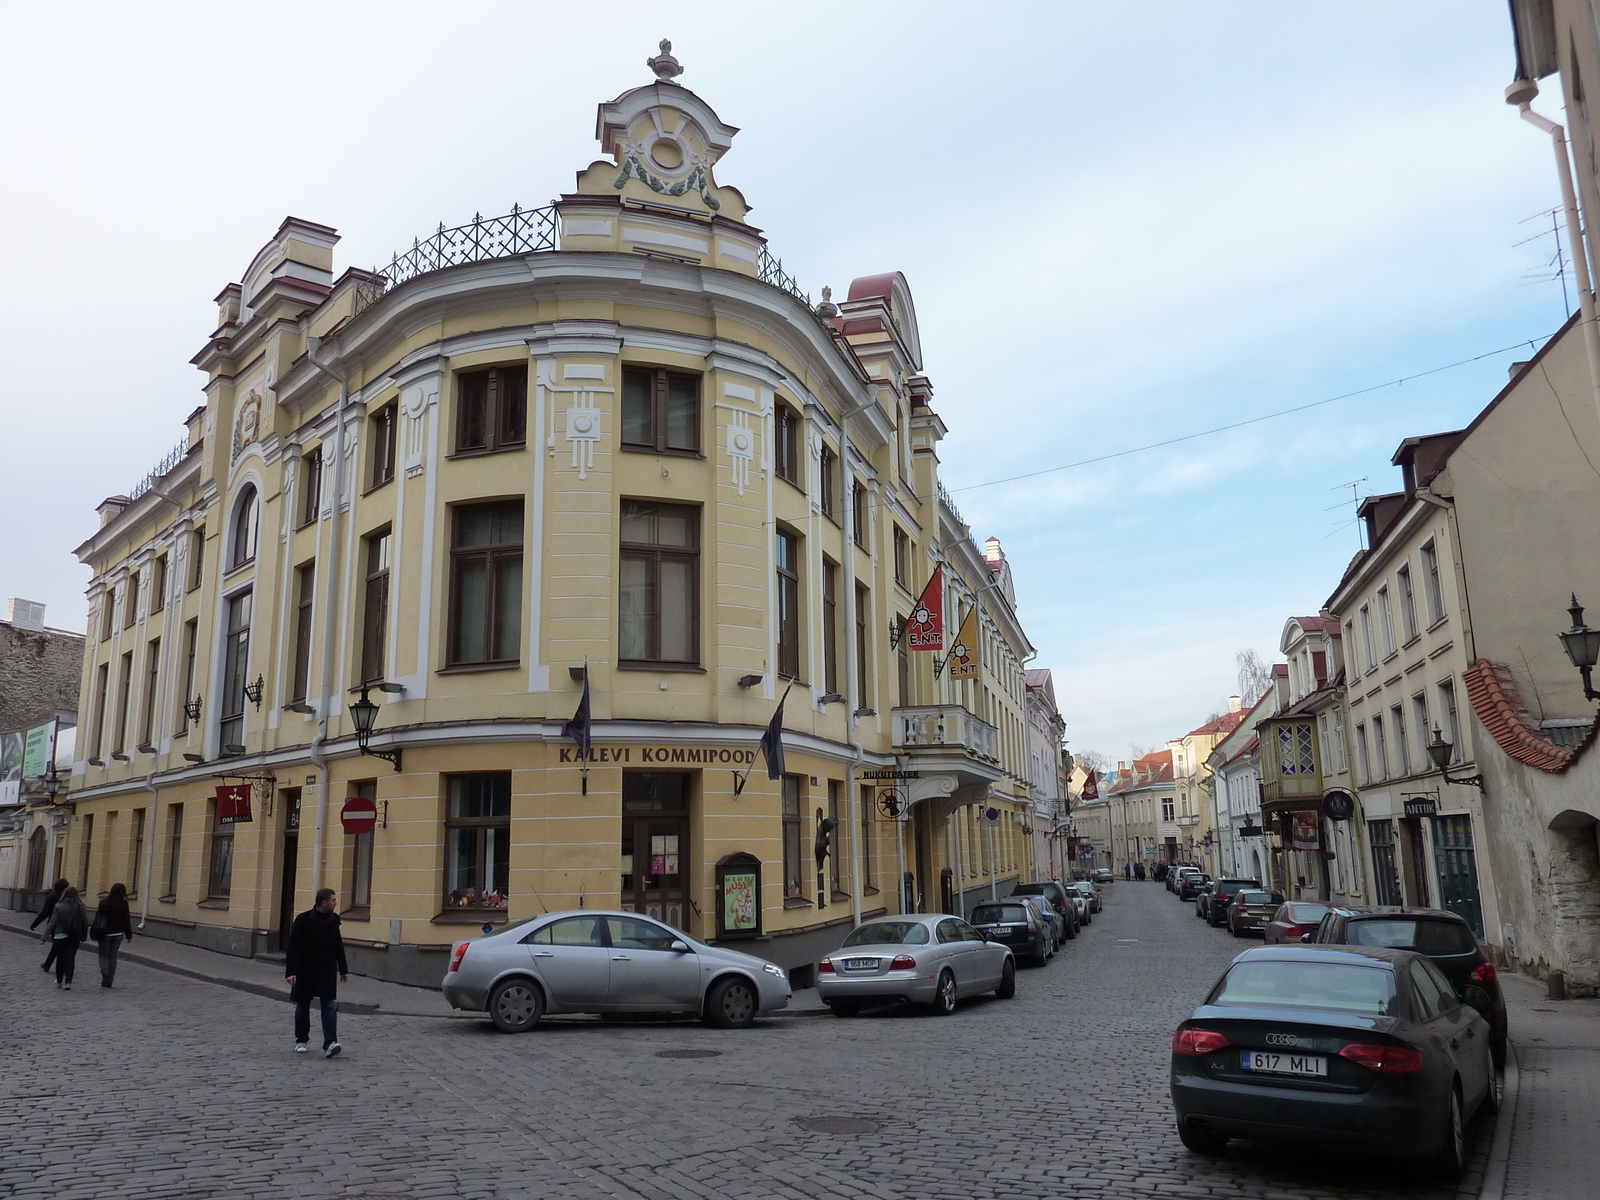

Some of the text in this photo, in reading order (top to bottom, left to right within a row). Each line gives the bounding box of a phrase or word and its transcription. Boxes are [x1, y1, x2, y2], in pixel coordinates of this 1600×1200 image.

[909, 633, 942, 645] E.N.T.
[950, 664, 978, 675] E.N.T.
[559, 748, 756, 764] KALEVI KOMMIPOOD
[863, 770, 920, 779] NUKUTEATER
[1405, 803, 1436, 815] ANTIIK
[1211, 1062, 1225, 1070] A4
[1255, 1054, 1280, 1069] 617
[1290, 1056, 1319, 1073] MLI
